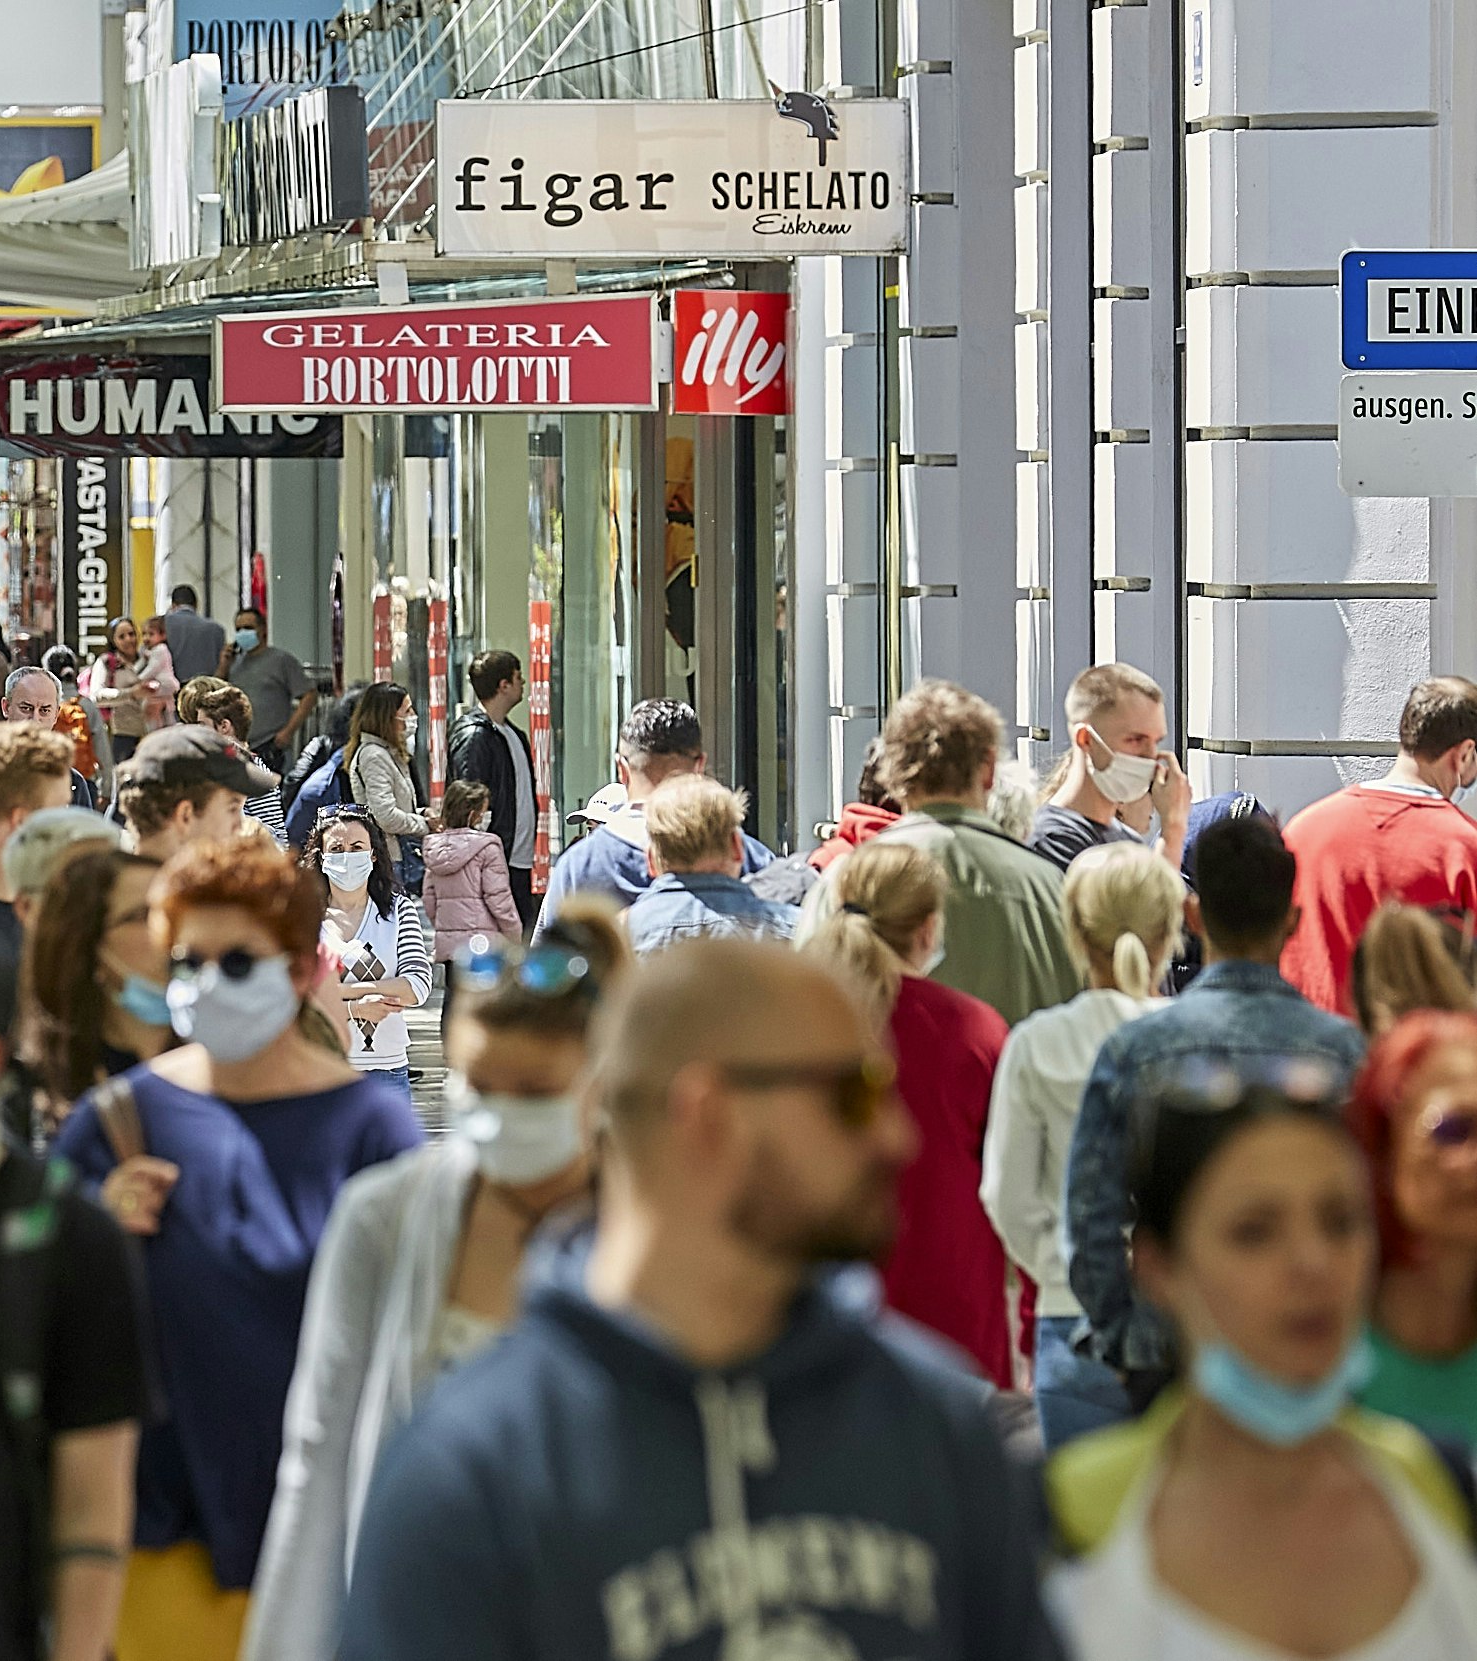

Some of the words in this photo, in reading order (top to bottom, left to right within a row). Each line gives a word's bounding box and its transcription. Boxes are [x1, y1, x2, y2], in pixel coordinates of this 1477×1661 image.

[454, 157, 675, 227] figar
[711, 171, 890, 211] SCHELATO
[752, 213, 852, 235] Eiskrem
[1388, 287, 1477, 334] EIN
[262, 323, 611, 348] GELATERIA
[681, 306, 786, 405] illy
[301, 355, 572, 404] BORTOLOTTI
[1352, 396, 1453, 425] ausgen.
